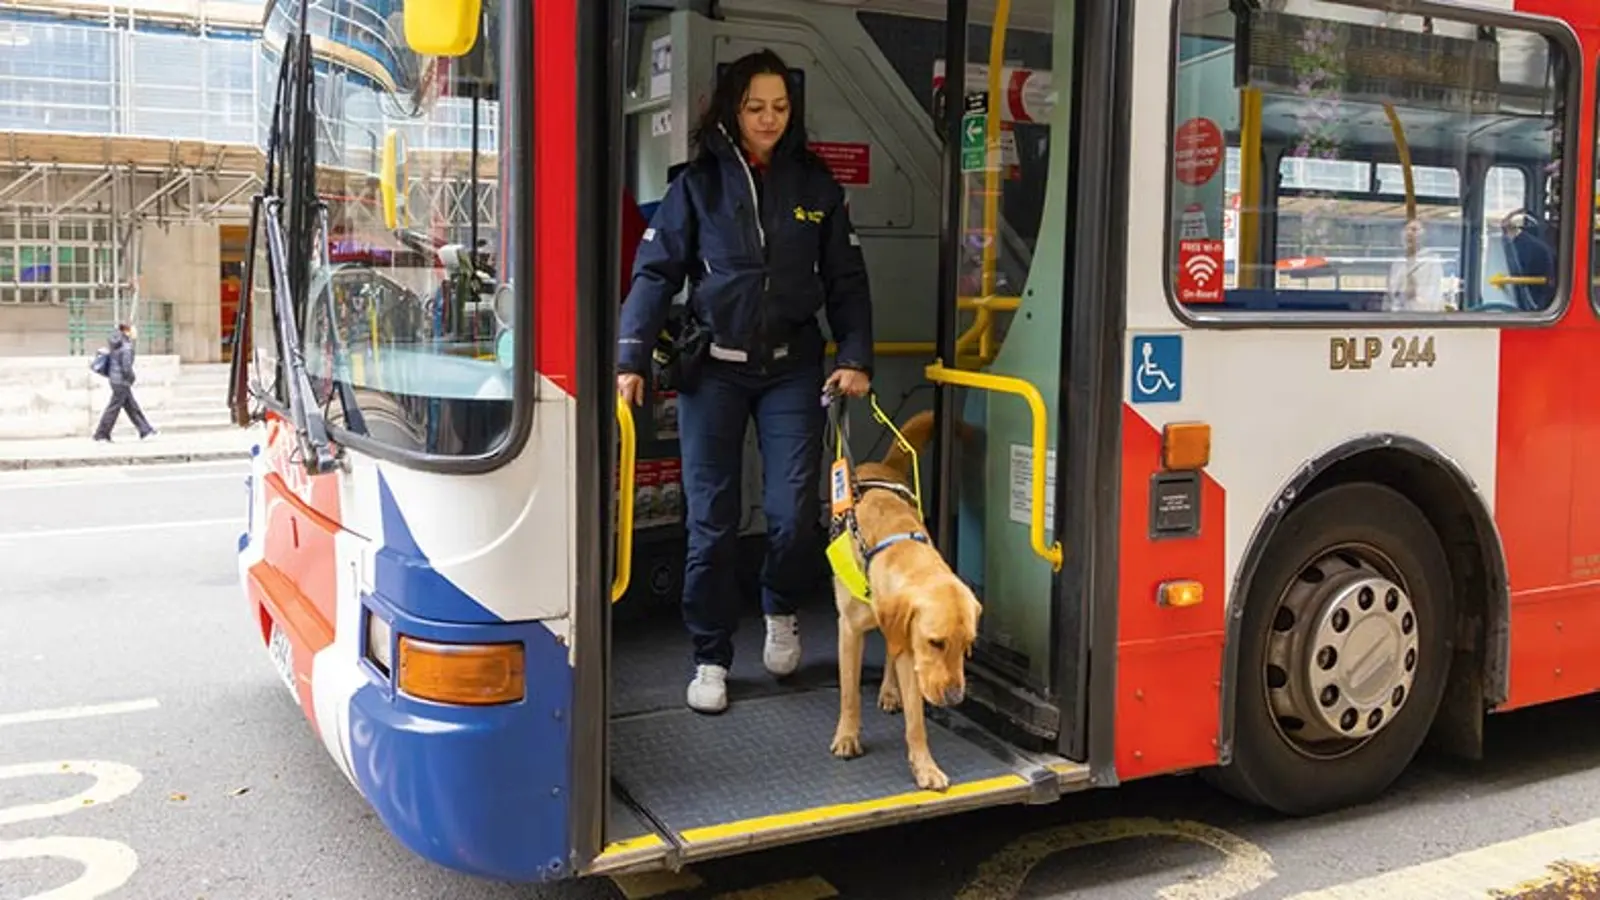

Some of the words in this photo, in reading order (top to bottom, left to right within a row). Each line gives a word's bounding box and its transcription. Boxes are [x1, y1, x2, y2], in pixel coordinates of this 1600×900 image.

[1181, 242, 1201, 253] FREE
[1182, 288, 1220, 299] On-Board
[1330, 336, 1383, 370] DLP
[1391, 335, 1436, 368] 244
